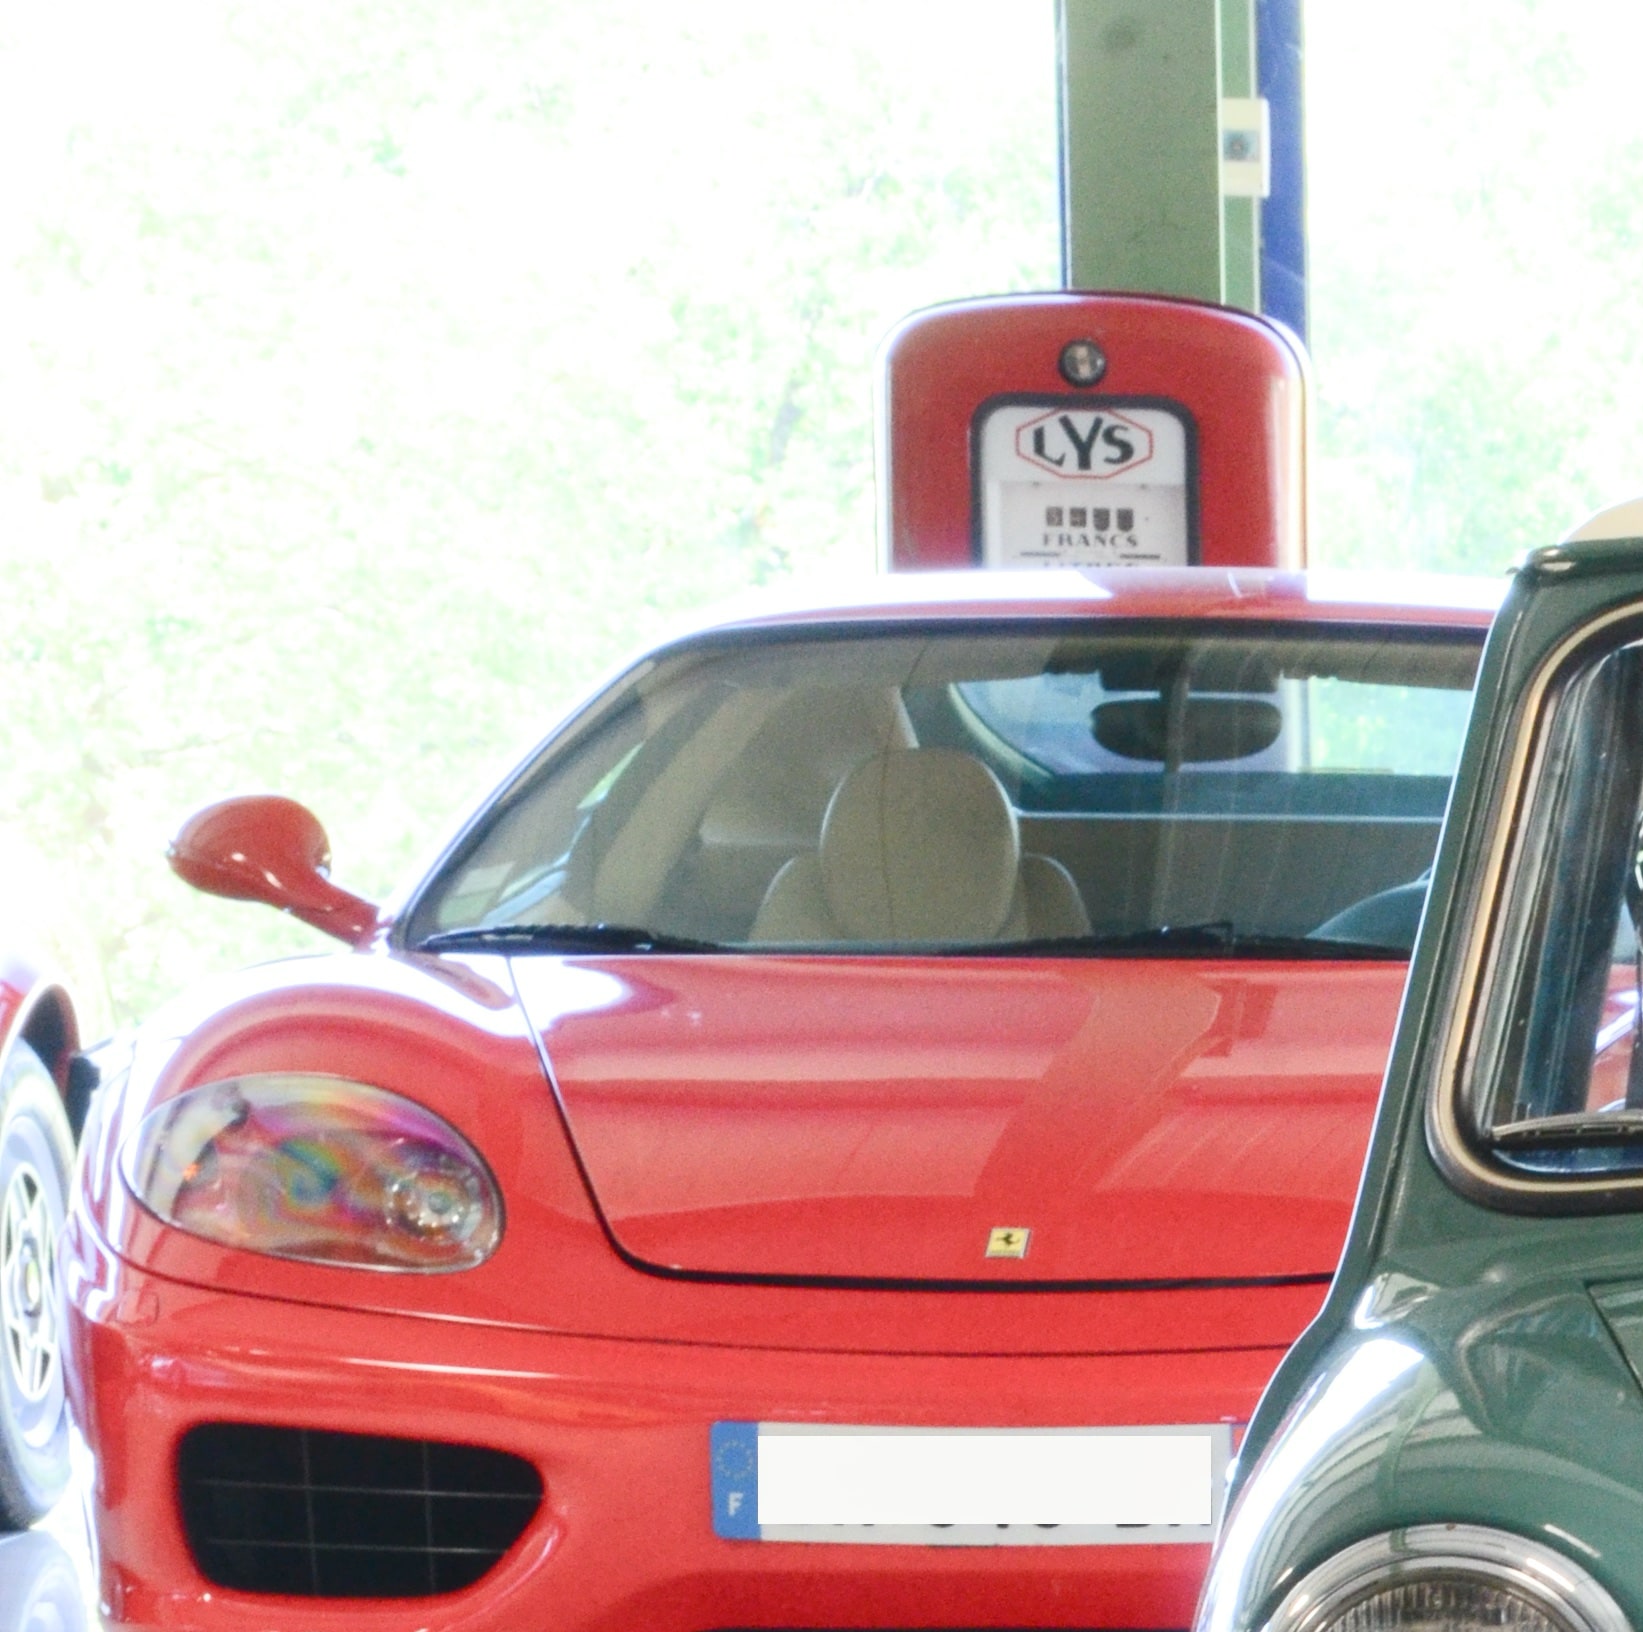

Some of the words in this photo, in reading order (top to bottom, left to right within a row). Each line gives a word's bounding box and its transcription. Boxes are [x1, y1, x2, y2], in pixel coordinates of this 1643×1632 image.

[1033, 414, 1134, 470] LYS
[1043, 533, 1138, 547] FRANCS
[729, 1492, 743, 1516] F
